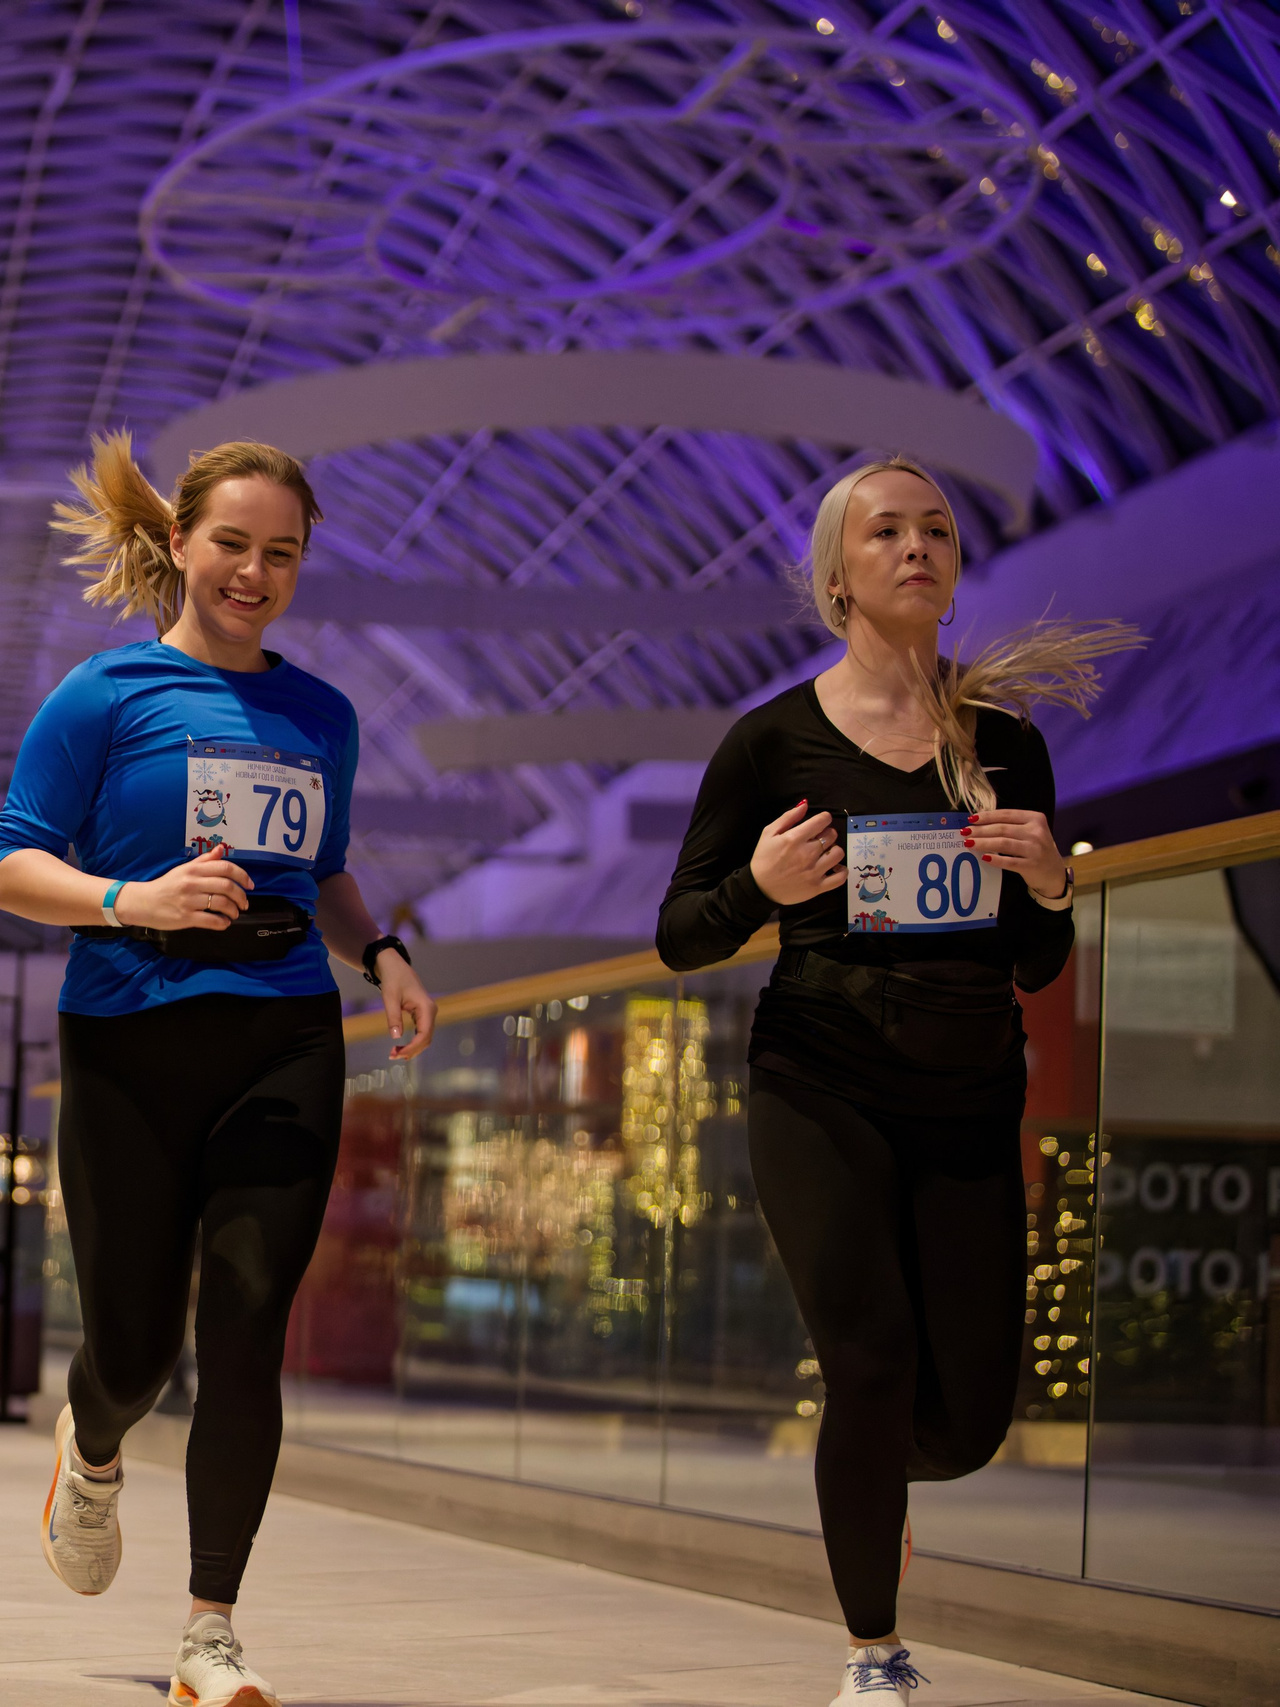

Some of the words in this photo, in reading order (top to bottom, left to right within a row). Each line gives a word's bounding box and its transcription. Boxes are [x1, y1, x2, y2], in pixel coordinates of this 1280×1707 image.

[247, 763, 271, 772] НОЧНОЙ
[236, 771, 257, 780] НОВЫЙ
[258, 773, 269, 781] ГОД
[253, 784, 307, 852] 79
[911, 832, 937, 841] НОЧНОЙ
[938, 831, 955, 840] ЗАБЕГ
[898, 842, 921, 850] НОВЫЙ
[923, 841, 935, 849] ГОД
[942, 840, 964, 849] ПЛАНЕТ
[917, 852, 981, 919] 80
